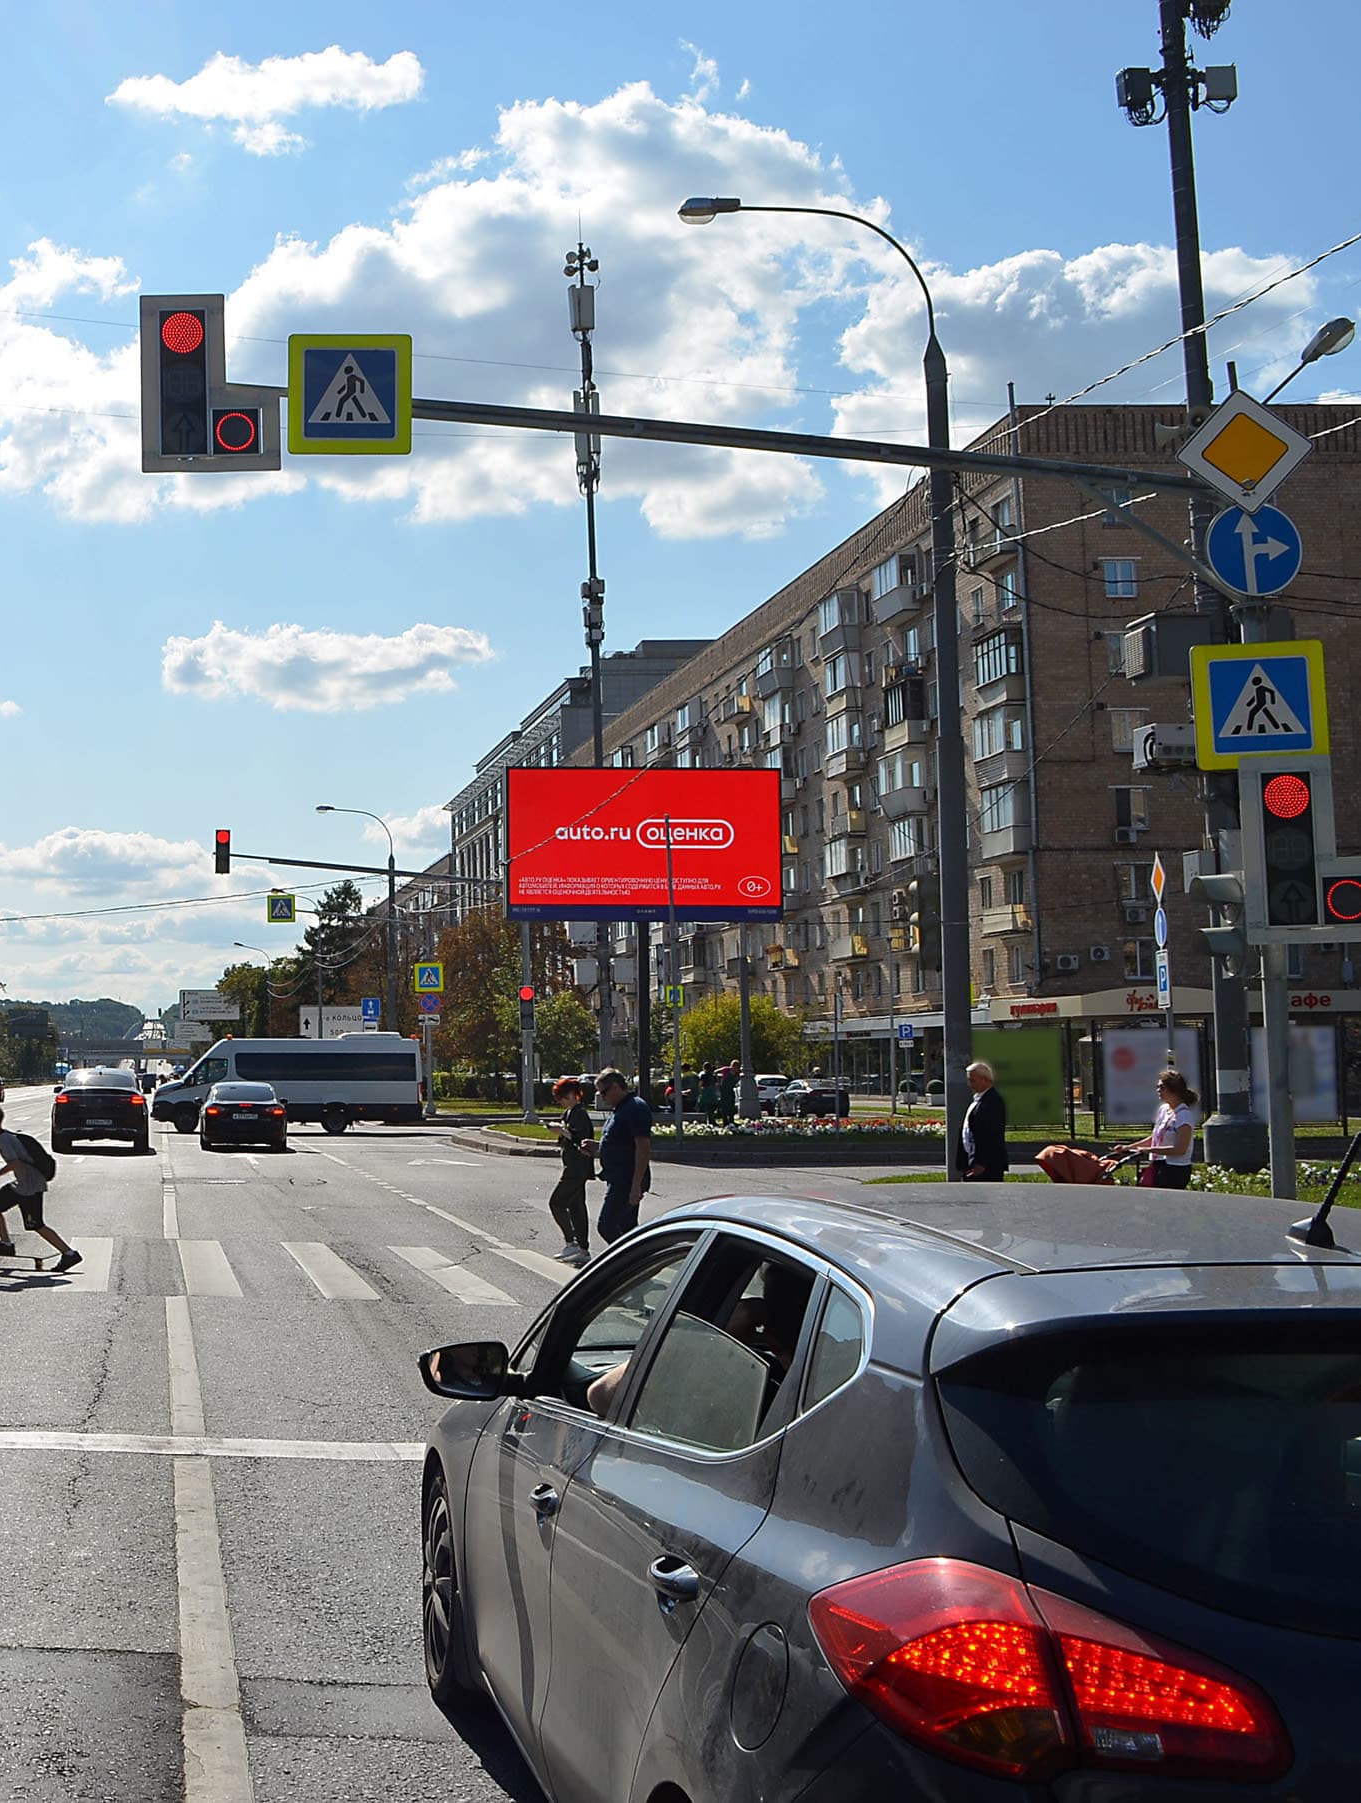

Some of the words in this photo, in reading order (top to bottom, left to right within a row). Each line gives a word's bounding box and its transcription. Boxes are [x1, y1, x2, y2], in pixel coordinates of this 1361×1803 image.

[555, 824, 631, 840] auto.ru
[646, 827, 724, 844] оценка
[746, 880, 763, 892] 0+
[1291, 992, 1331, 1009] афе
[902, 1026, 911, 1038] P
